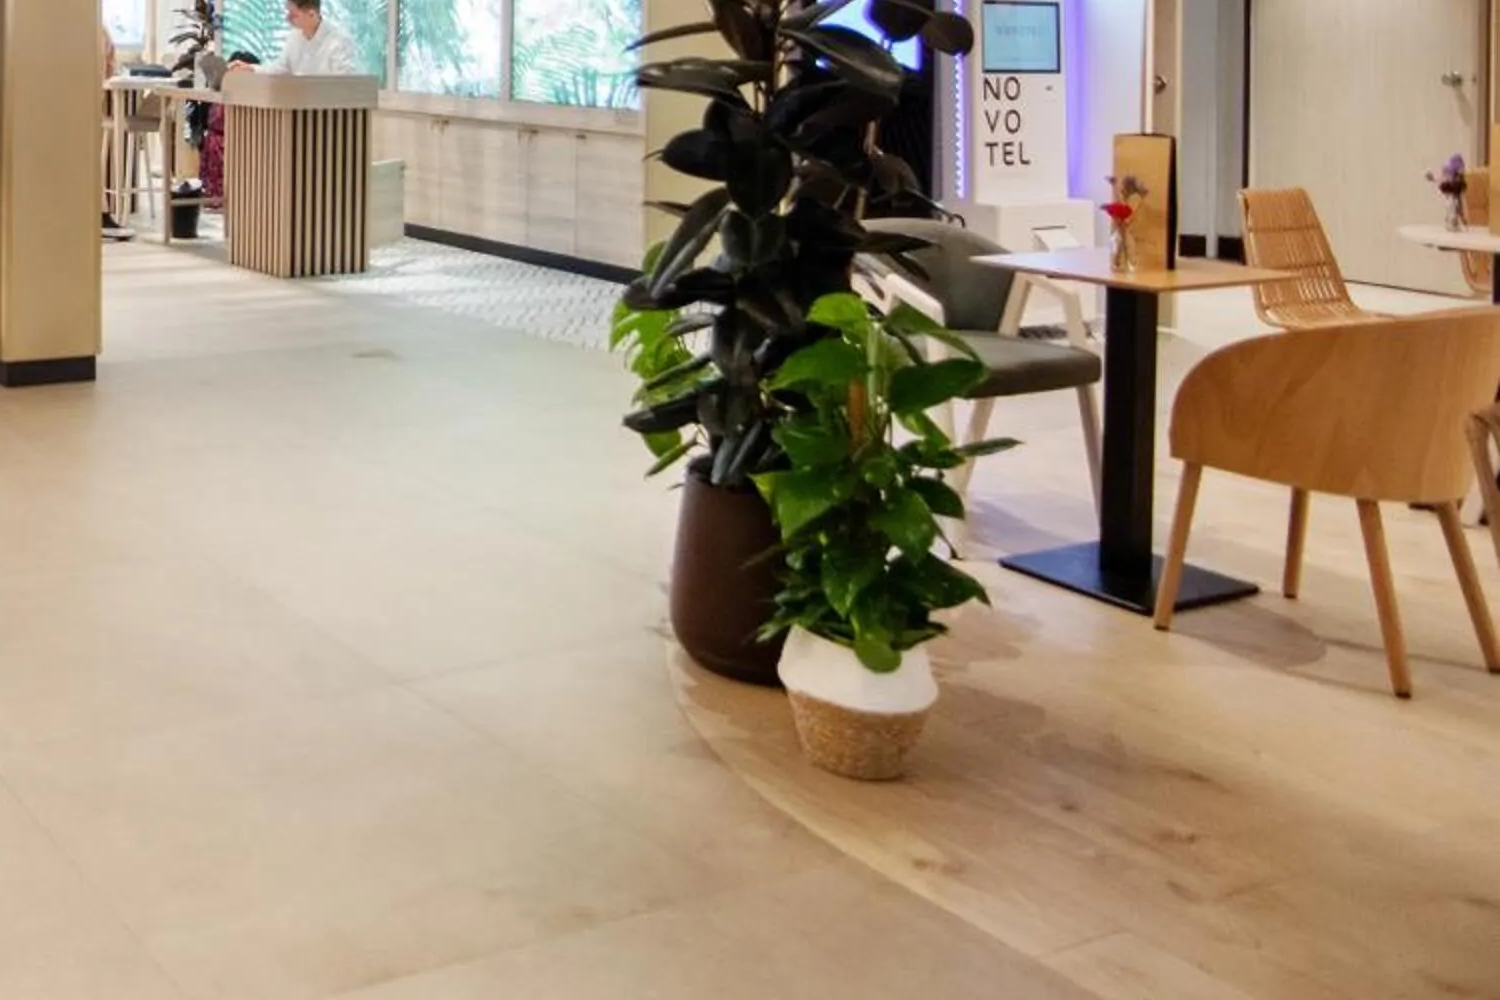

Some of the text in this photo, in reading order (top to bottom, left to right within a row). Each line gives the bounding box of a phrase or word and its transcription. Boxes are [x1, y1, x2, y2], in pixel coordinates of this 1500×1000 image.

[983, 76, 1021, 101] NO
[984, 109, 1021, 134] VO
[984, 141, 1031, 167] TEL
